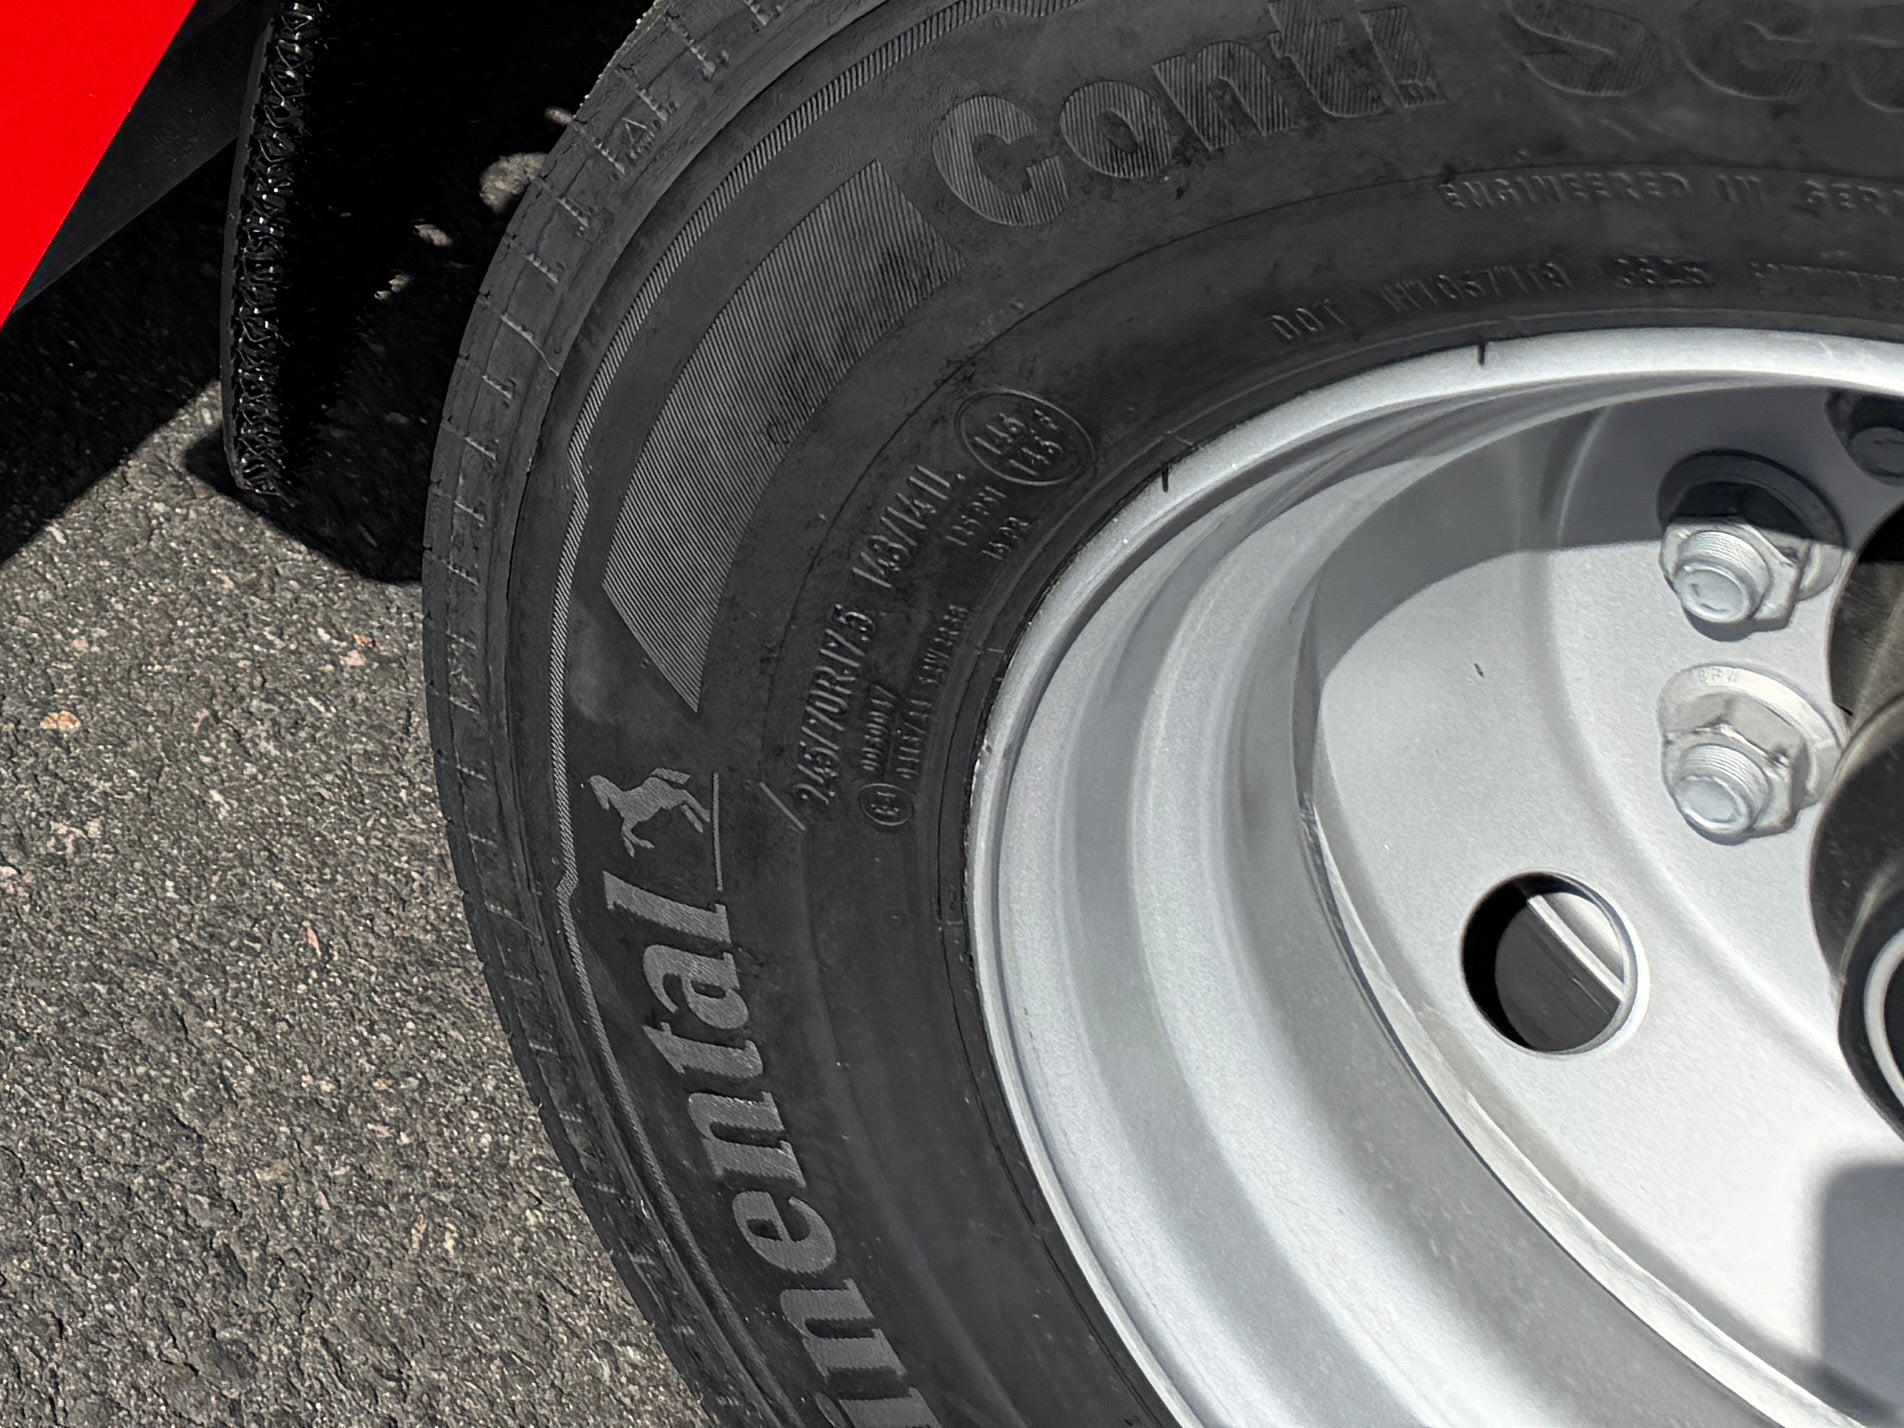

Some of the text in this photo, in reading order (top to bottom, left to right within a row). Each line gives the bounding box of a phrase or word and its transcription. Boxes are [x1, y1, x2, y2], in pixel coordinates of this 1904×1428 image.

[1437, 169, 1904, 218] ENGINEERED IN GER
[1272, 297, 1349, 342] DOT
[794, 603, 876, 806] 245/70R17.5
[852, 464, 966, 589] 143/141L
